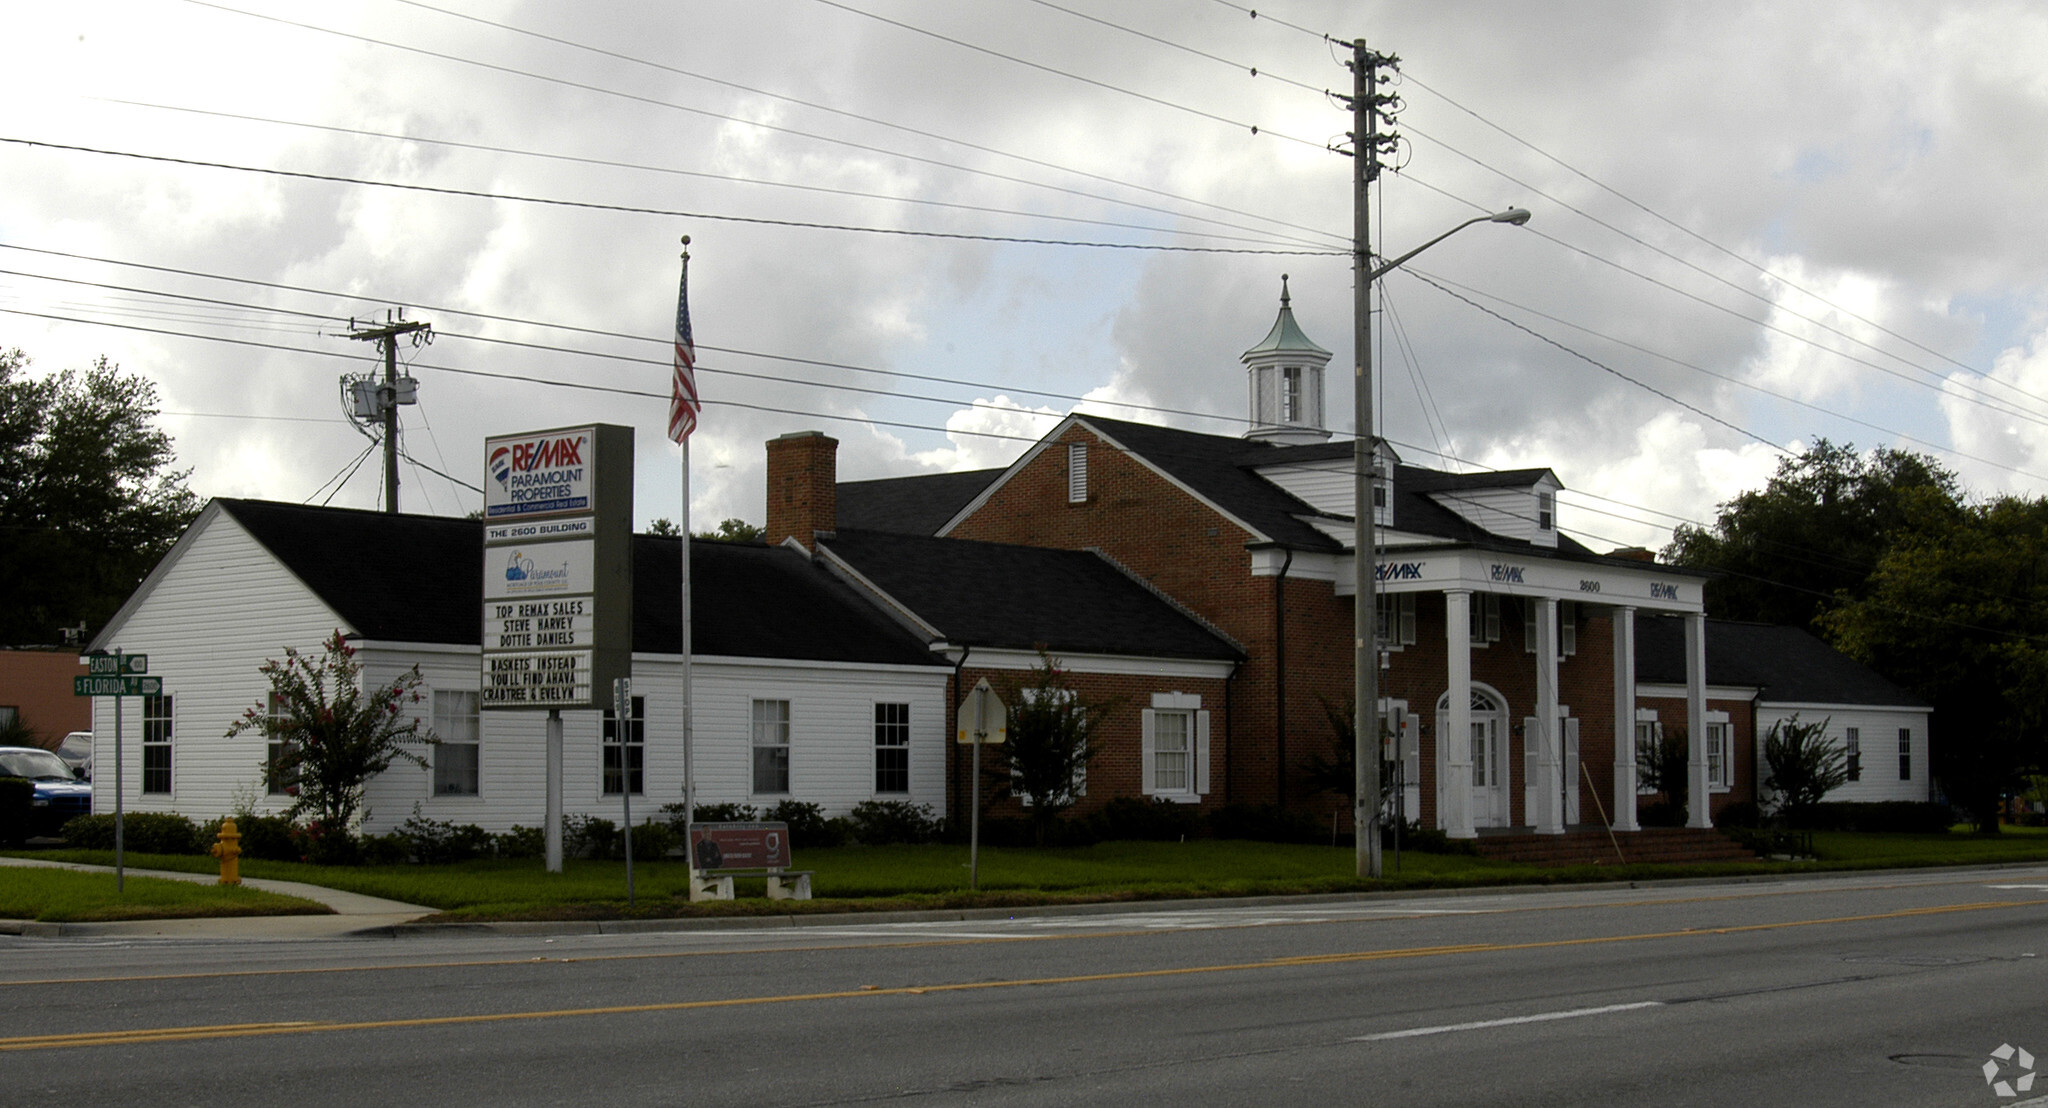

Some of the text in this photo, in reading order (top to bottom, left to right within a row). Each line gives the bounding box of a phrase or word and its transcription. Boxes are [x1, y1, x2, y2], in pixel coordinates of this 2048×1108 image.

[512, 436, 583, 472] RE/MAX
[511, 469, 583, 488] PARAMOUNT
[511, 484, 572, 502] PROPERTIES
[490, 522, 587, 538] THE 2600 BUILDING
[1491, 563, 1525, 583] RE/MAX
[1580, 580, 1600, 592] 2600
[496, 601, 583, 619] TOP REMAX SALES
[504, 617, 573, 633] STEVE HARVEY
[500, 632, 574, 647] DOTTIE DANIELS
[90, 657, 118, 673] EASTON
[491, 657, 576, 672] BASKETS INSTEAD
[76, 681, 81, 692] S
[83, 678, 127, 694] FLORIDA
[523, 672, 543, 685] FIND
[546, 671, 575, 684] AHAVA
[483, 686, 574, 701] CRABTREE & EVELYN
